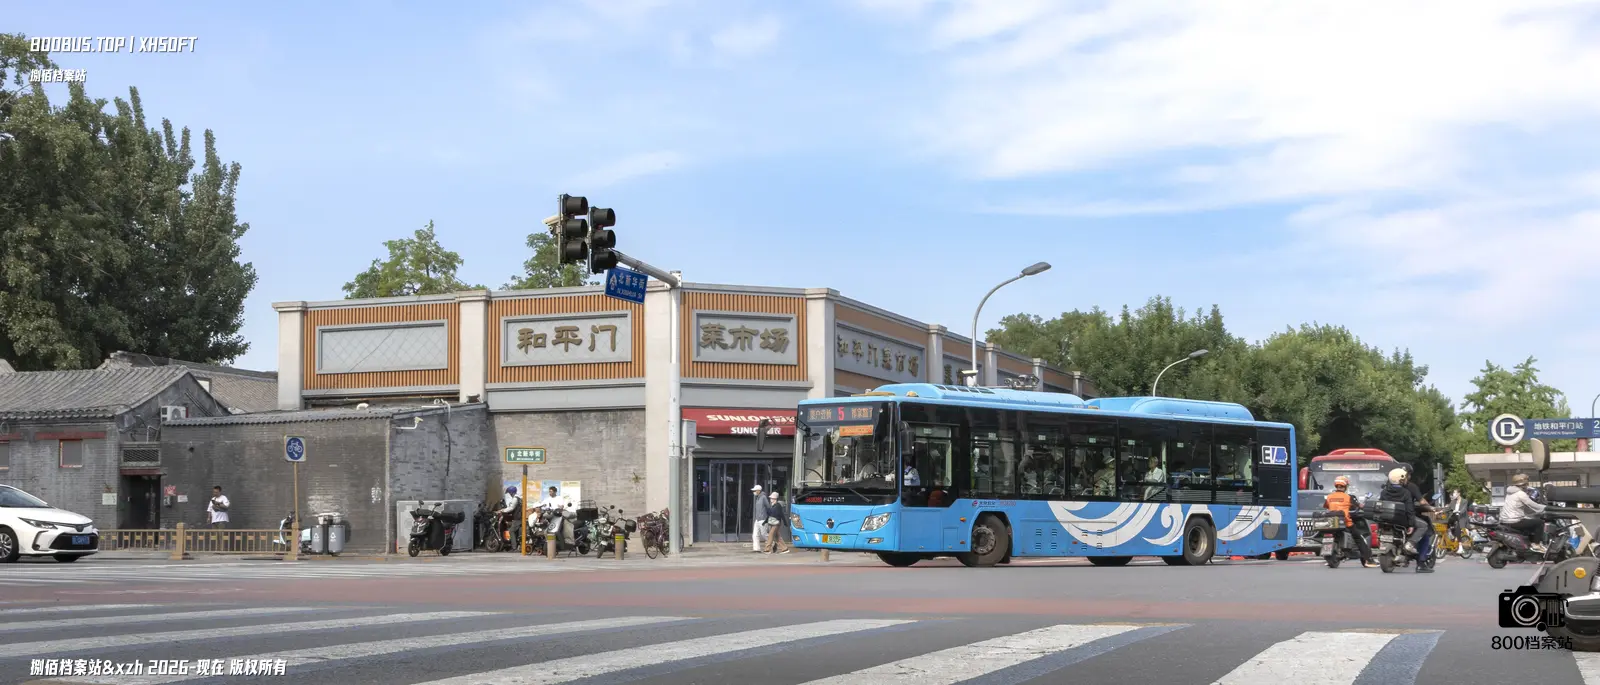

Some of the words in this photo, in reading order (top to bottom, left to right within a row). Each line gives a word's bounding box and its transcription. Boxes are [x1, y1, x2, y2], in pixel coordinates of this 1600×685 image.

[517, 324, 618, 353] 和平门
[700, 323, 790, 353] 菜市场
[838, 406, 845, 421] 5
[1533, 422, 1583, 430] 地铁和平门站
